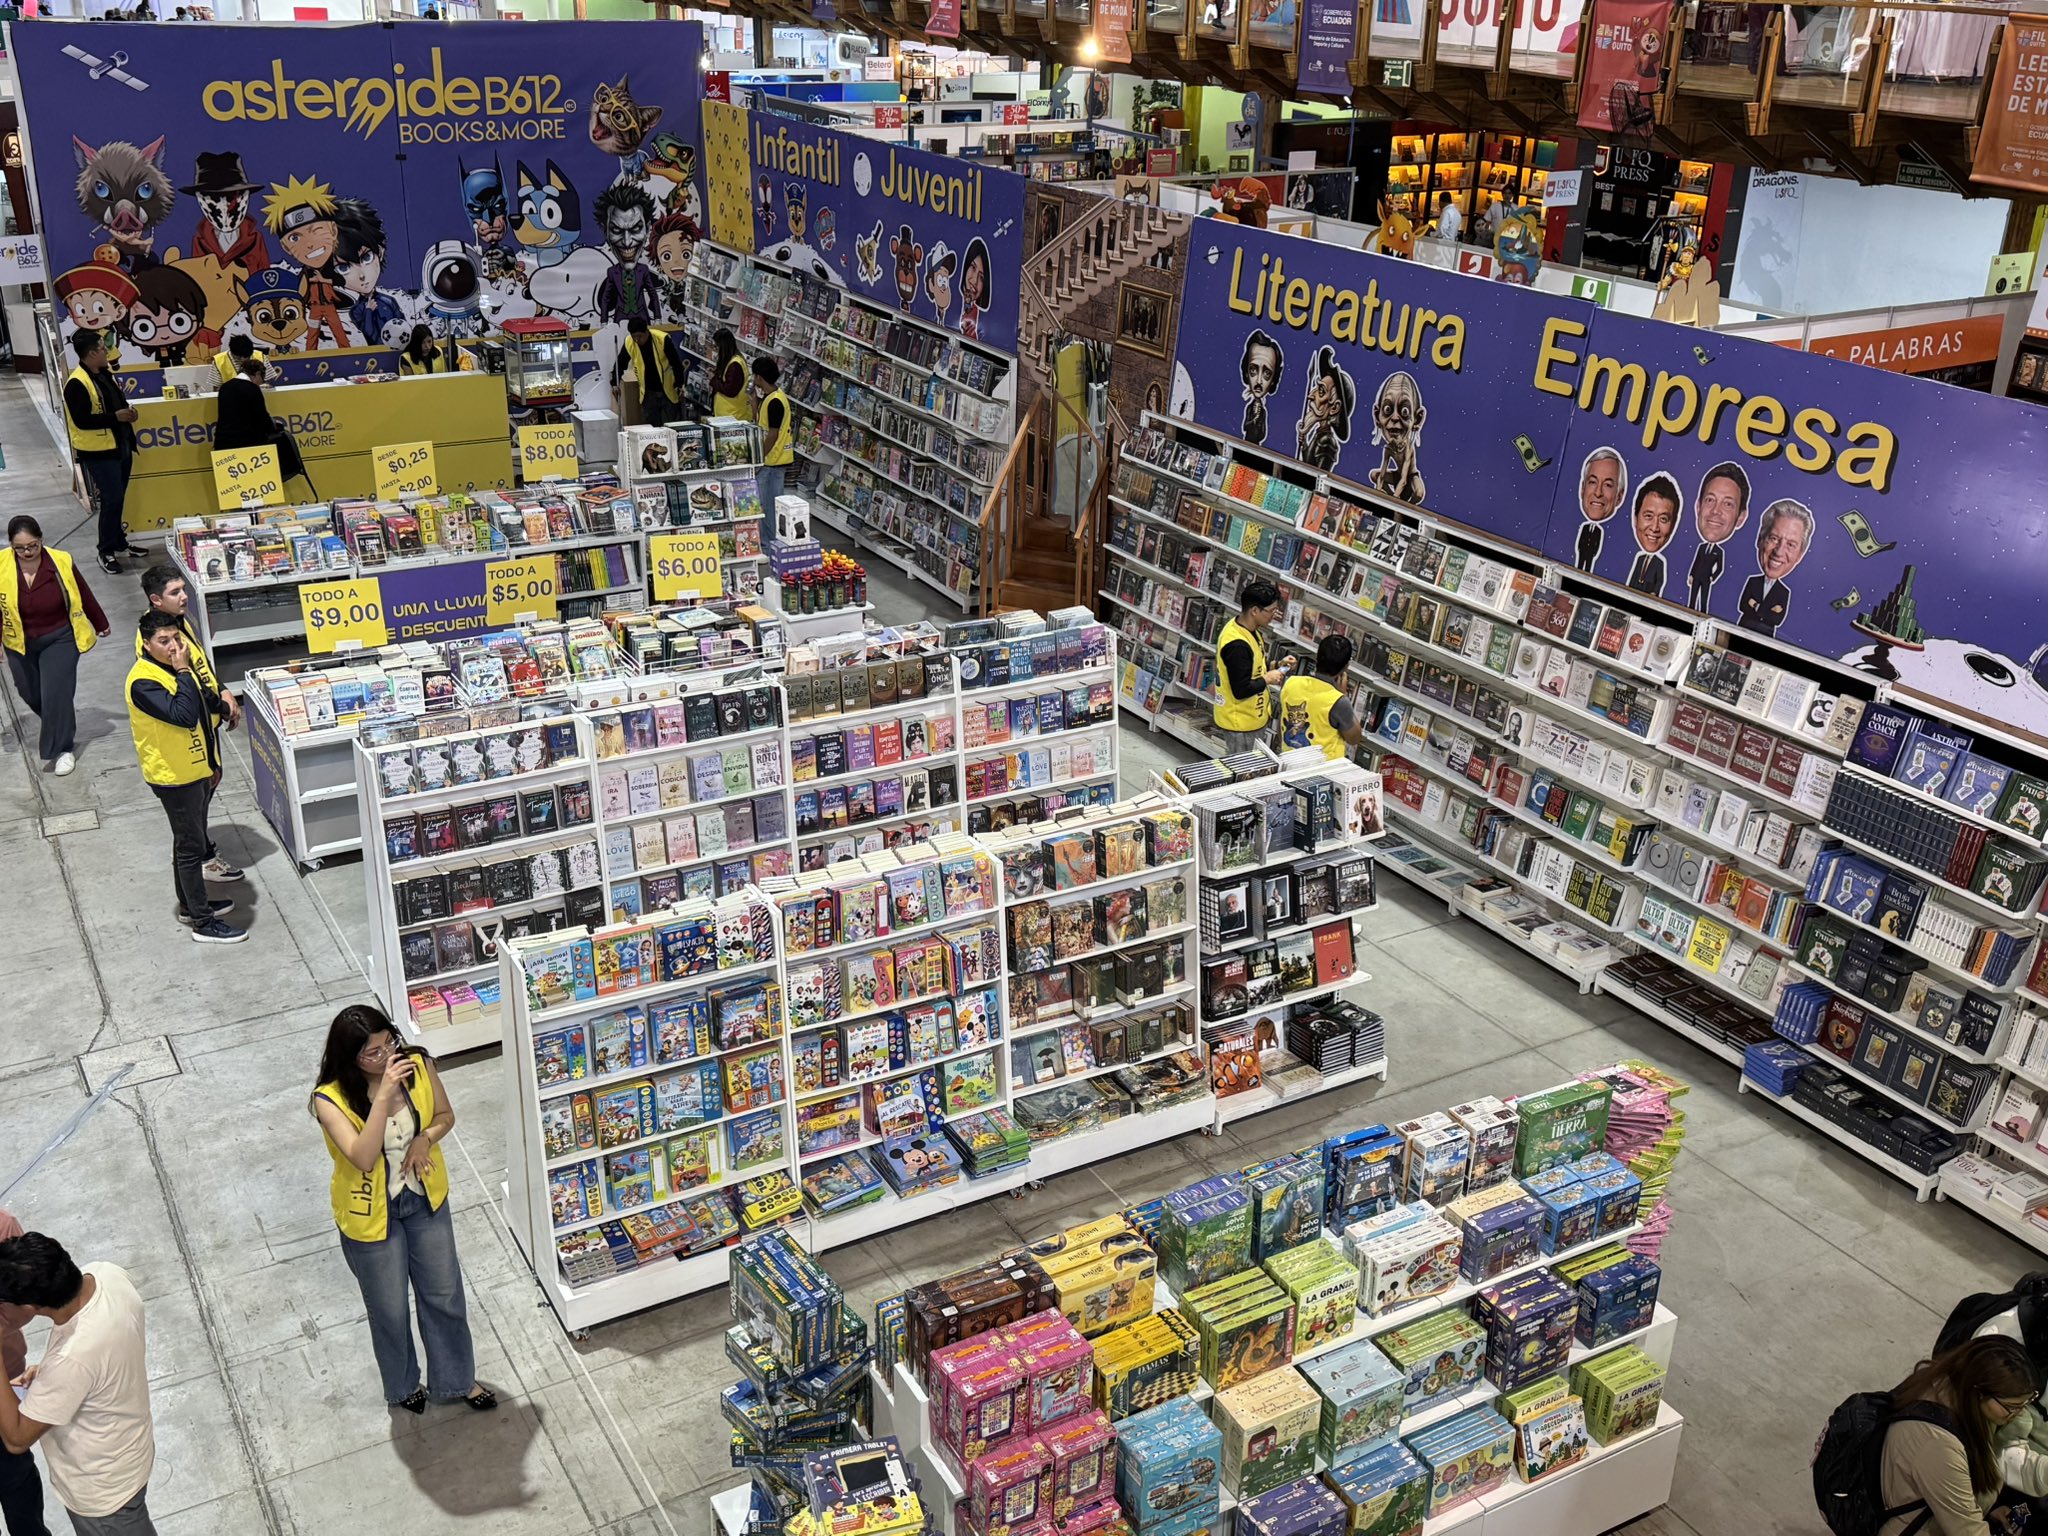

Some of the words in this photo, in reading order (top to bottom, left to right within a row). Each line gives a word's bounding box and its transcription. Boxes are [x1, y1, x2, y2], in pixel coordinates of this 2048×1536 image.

[1100, 4, 1110, 14] DE
[1111, 5, 1128, 16] MODA
[1322, 16, 1352, 25] ECUADOR
[1613, 26, 1633, 43] FIL
[2031, 31, 2046, 42] FIL
[1611, 41, 1632, 51] QUITO
[203, 47, 481, 140] asteroide
[484, 75, 564, 117] B612
[2008, 95, 2031, 113] DE
[400, 118, 566, 144] BOOKS&MORE
[755, 121, 841, 187] Infantil
[880, 152, 983, 223] Juvenil
[1613, 165, 1650, 182] PRESS
[1595, 181, 1615, 191] BEST
[1752, 176, 1800, 188] DRAGONS.
[1555, 189, 1575, 198] PRESS
[1850, 331, 1964, 364] PALABRAS
[1228, 247, 1466, 371] Literatura
[1535, 317, 1897, 491] Empresa
[289, 411, 334, 434] B612
[534, 430, 565, 441] TODO
[566, 429, 575, 439] A
[525, 443, 577, 464] $8,00
[227, 452, 271, 481] $0,25
[388, 447, 428, 475] $0,25
[239, 480, 277, 502] $2,00
[669, 542, 700, 553] TODO
[707, 541, 716, 550] A
[488, 567, 524, 580] TODO
[527, 565, 536, 575] A
[657, 556, 718, 580] $6,00
[302, 590, 344, 604] TODO
[348, 588, 358, 598] A
[491, 579, 552, 603] $5,00
[310, 603, 379, 629] $9,00
[393, 603, 429, 617] UNA
[402, 615, 487, 637] DESCUENT
[1550, 613, 1566, 627] 360
[1035, 645, 1056, 653] OLVIDO
[1062, 640, 1082, 649] OLVIDO
[1011, 665, 1032, 676] BRILLA
[1680, 719, 1695, 730] PODER
[1870, 712, 1899, 728] ASTRO
[1868, 721, 1896, 737] COACH
[1549, 732, 1557, 745] 7
[1710, 732, 1727, 743] PODER
[1569, 741, 1577, 754] 7
[1744, 746, 1761, 758] PODER
[757, 752, 777, 764] ROTO
[1076, 752, 1091, 760] HATE
[724, 763, 748, 773] ENVIDIA
[1031, 762, 1049, 771] LOVE
[1779, 760, 1796, 772] PODER
[660, 775, 686, 784] CODICIA
[697, 770, 721, 778] DESIDIA
[1351, 781, 1380, 794] PERRO
[1407, 785, 1422, 796] BRAND
[1408, 780, 1423, 790] STORY
[673, 832, 692, 842] HATE
[704, 828, 722, 837] LIES
[606, 845, 629, 855] LOVE
[637, 839, 663, 849] GAMES
[1342, 865, 1366, 876] GUERRA
[1572, 869, 1584, 883] GLO
[612, 890, 636, 899] JUEGO
[1570, 882, 1582, 896] BAL
[1599, 883, 1612, 897] GLO
[1891, 887, 1911, 904] Bruja
[1595, 895, 1609, 908] BAL
[1592, 906, 1610, 922] ISMO
[1644, 905, 1664, 921] ULTRA
[1668, 919, 1689, 934] ULTRA
[1319, 931, 1341, 943] FRANK
[1552, 1117, 1587, 1139] TIERRA
[1953, 1159, 1979, 1174] YOGA
[1206, 1222, 1245, 1242] misteriosa
[1487, 1235, 1496, 1243] Un
[1382, 1263, 1407, 1277] MICKEY
[1306, 1294, 1317, 1304] LA
[1138, 1355, 1169, 1375] DAMAS
[1619, 1393, 1629, 1401] LA
[1521, 1406, 1532, 1416] LA
[831, 1444, 861, 1458] PRIMERA
[863, 1441, 887, 1450] TABLET
